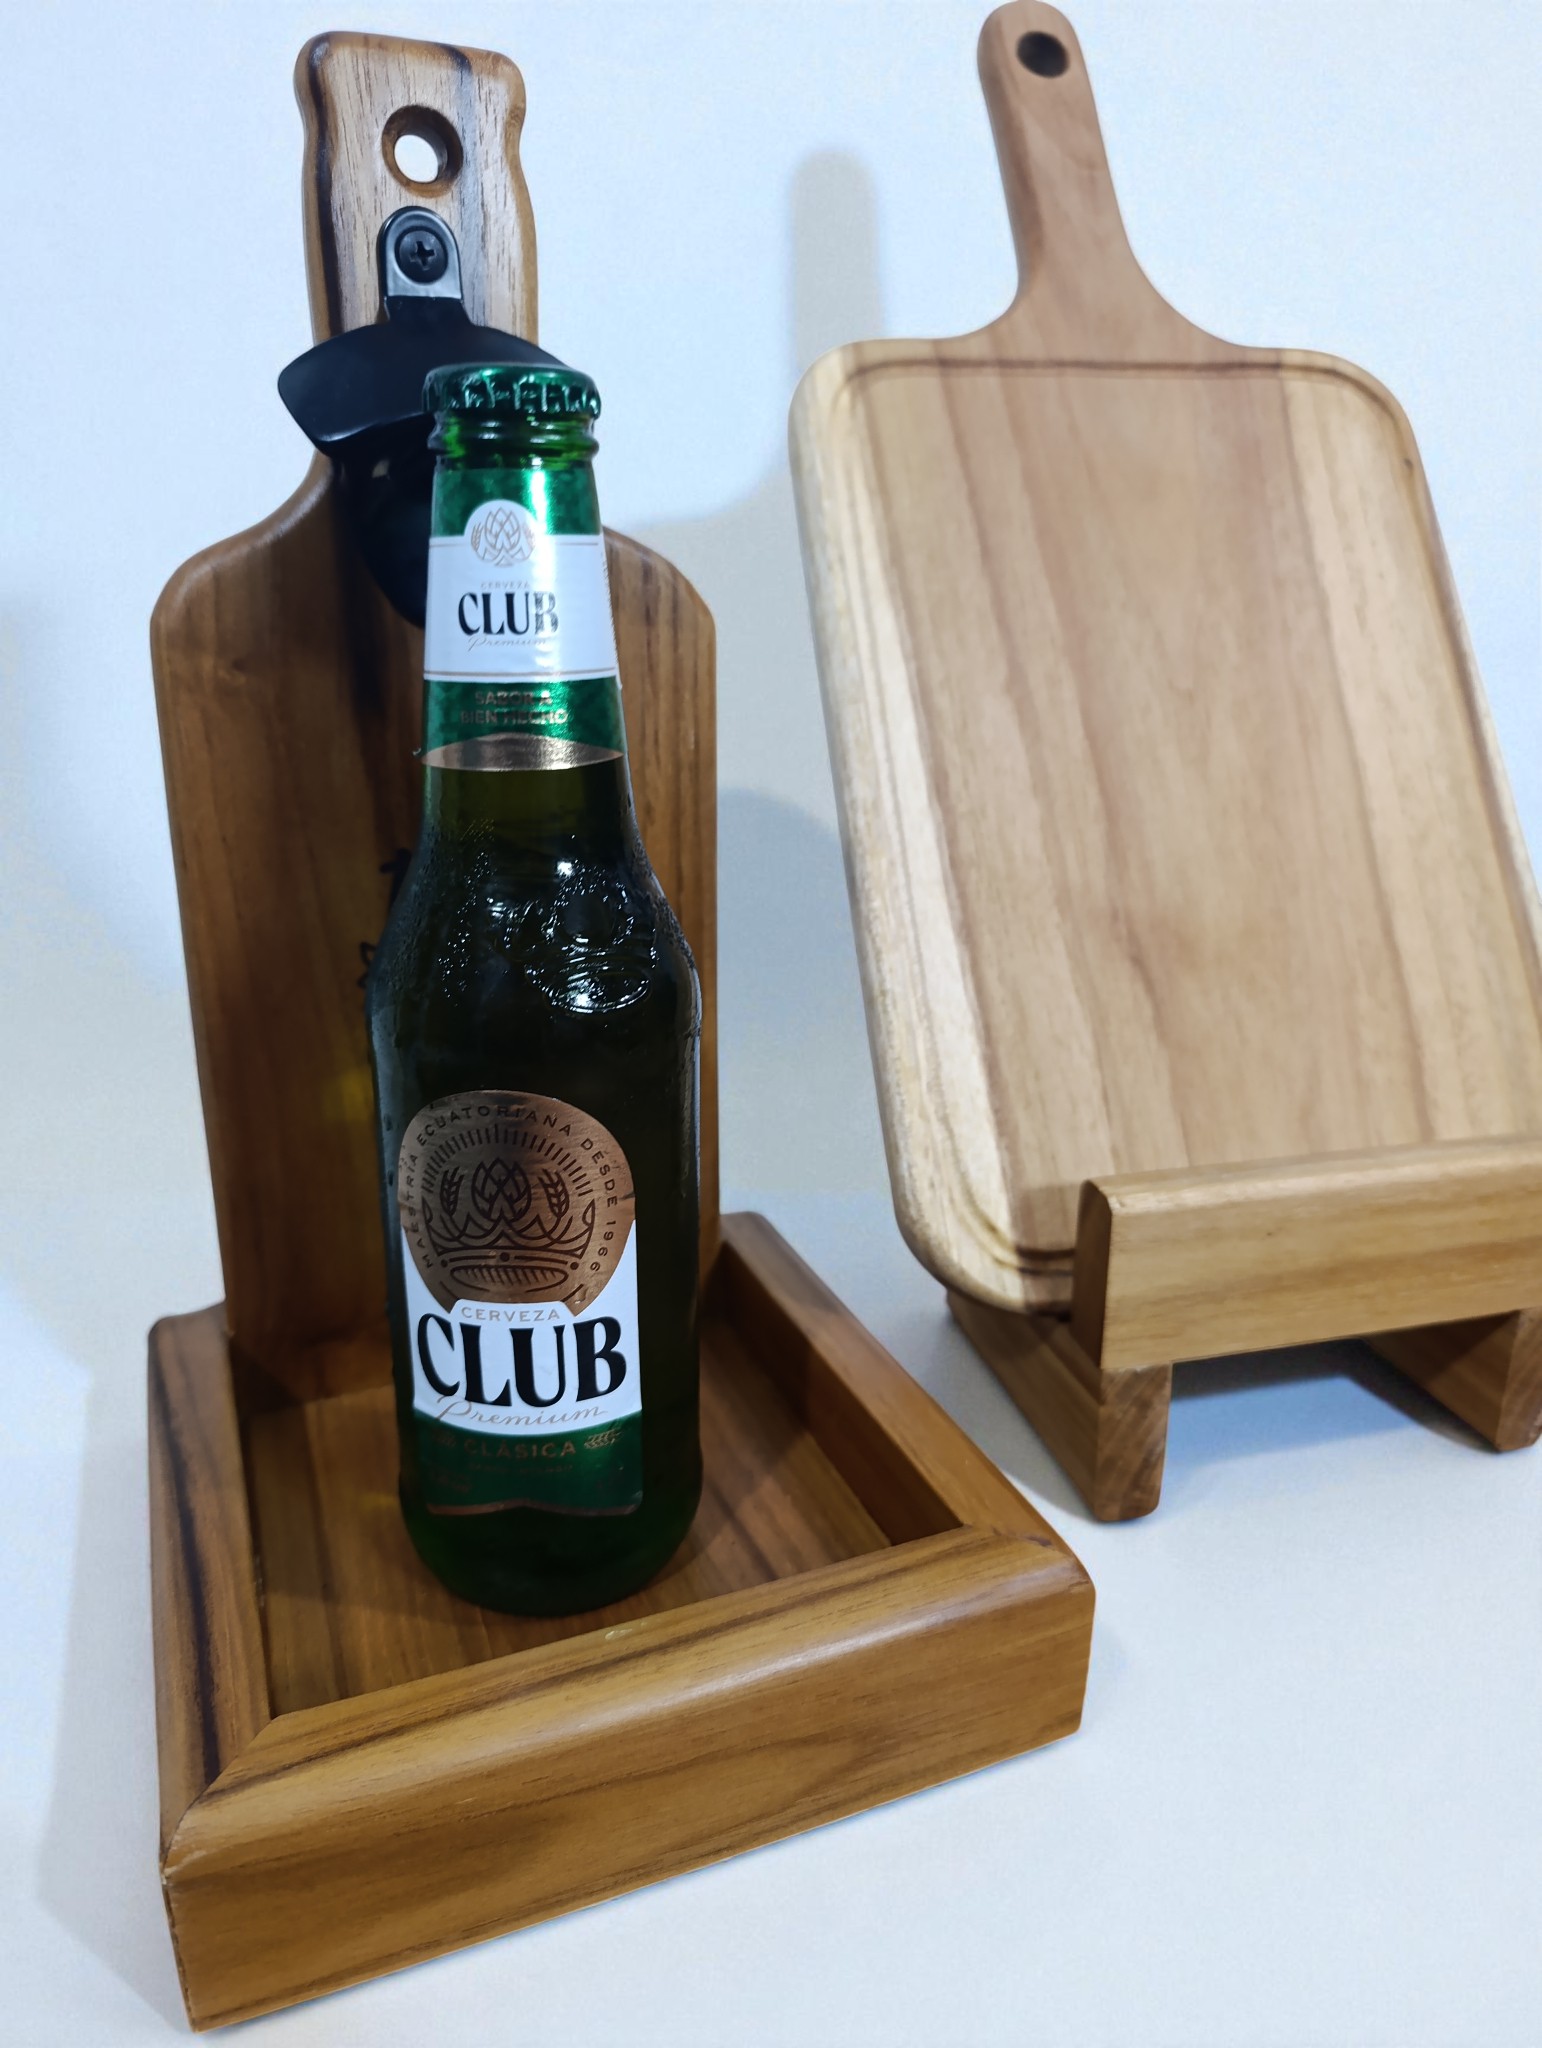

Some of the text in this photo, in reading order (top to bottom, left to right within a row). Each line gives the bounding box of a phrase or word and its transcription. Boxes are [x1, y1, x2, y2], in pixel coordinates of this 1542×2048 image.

[458, 591, 559, 636] CLUB
[475, 690, 535, 705] SABOR
[415, 1104, 573, 1147] ECUATORIANA
[580, 1138, 618, 1208] DESDE
[590, 1219, 618, 1272] 1966
[460, 1305, 561, 1323] CERVEZA
[417, 1312, 628, 1409] CLUB
[434, 1394, 608, 1427] Premium
